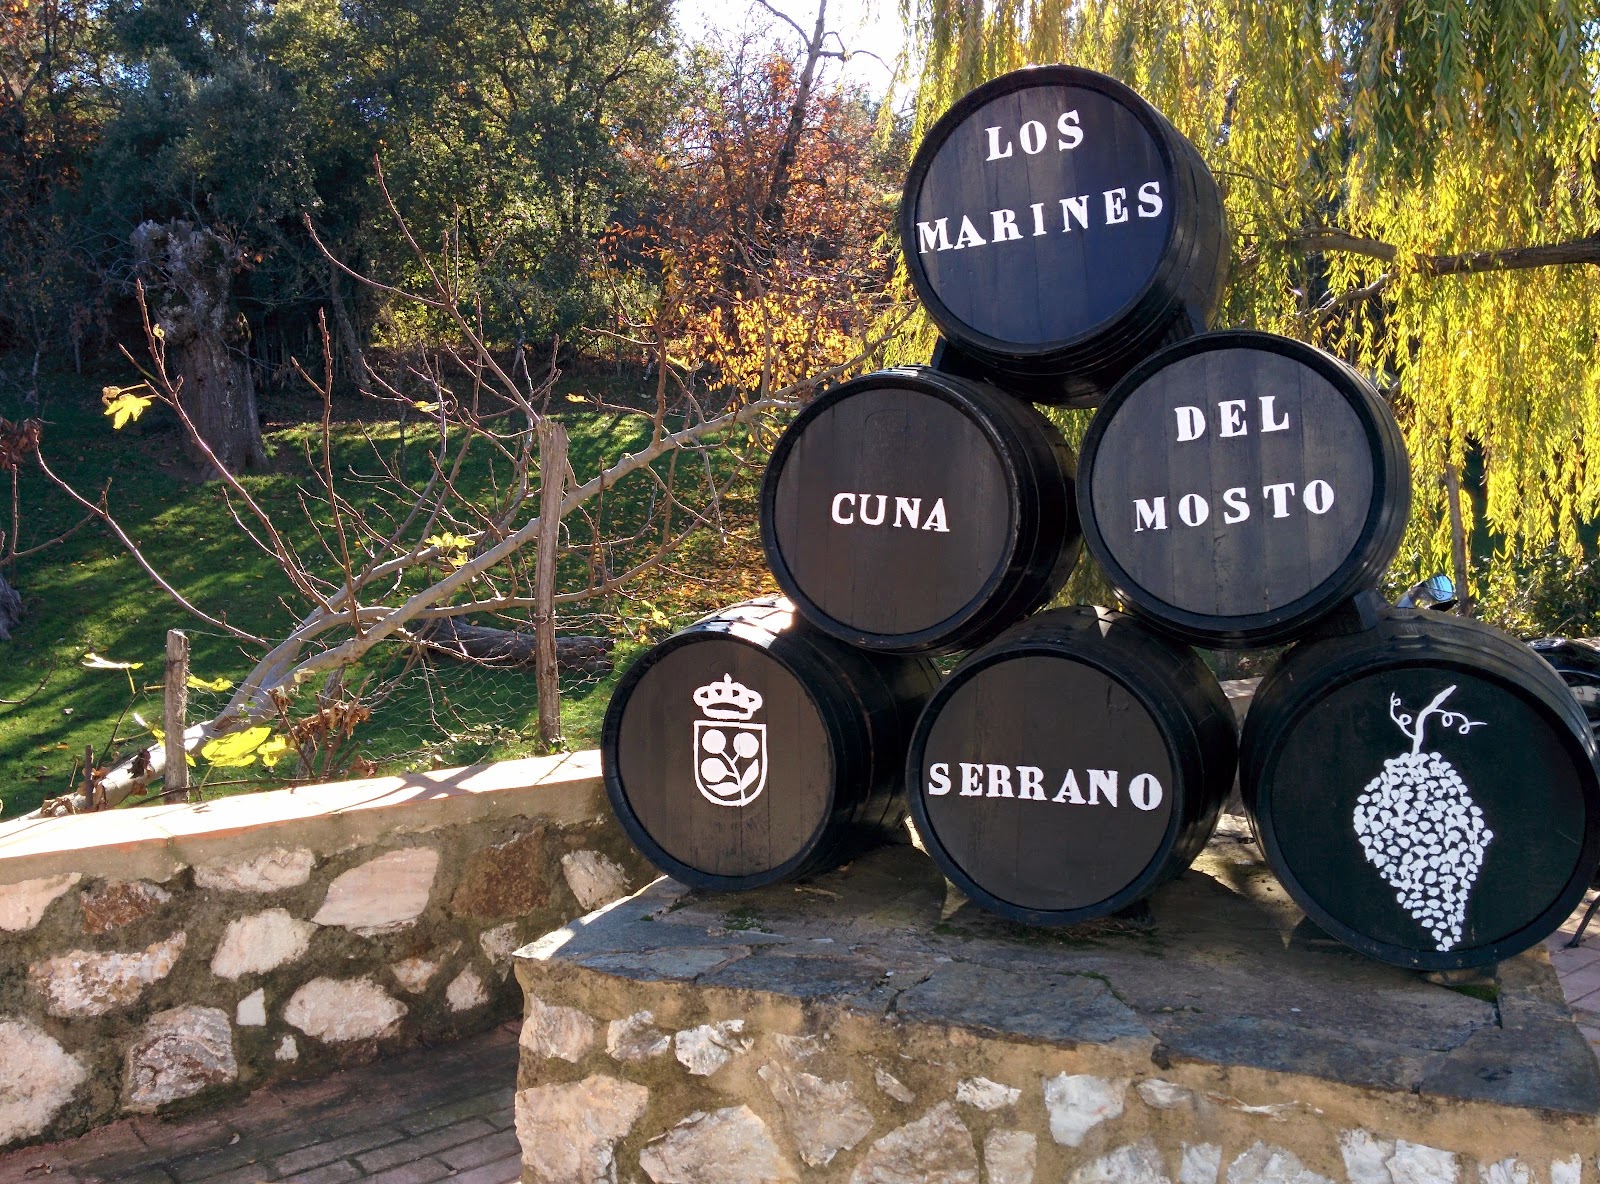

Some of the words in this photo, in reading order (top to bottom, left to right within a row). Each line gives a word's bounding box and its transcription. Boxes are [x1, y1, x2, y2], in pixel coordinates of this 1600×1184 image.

[984, 109, 1084, 162] LOS
[916, 181, 1163, 254] MARINES
[1173, 395, 1290, 442] DEL
[831, 492, 950, 533] CUNA
[1133, 479, 1335, 533] MOSTO
[928, 762, 1163, 811] SERRANO
